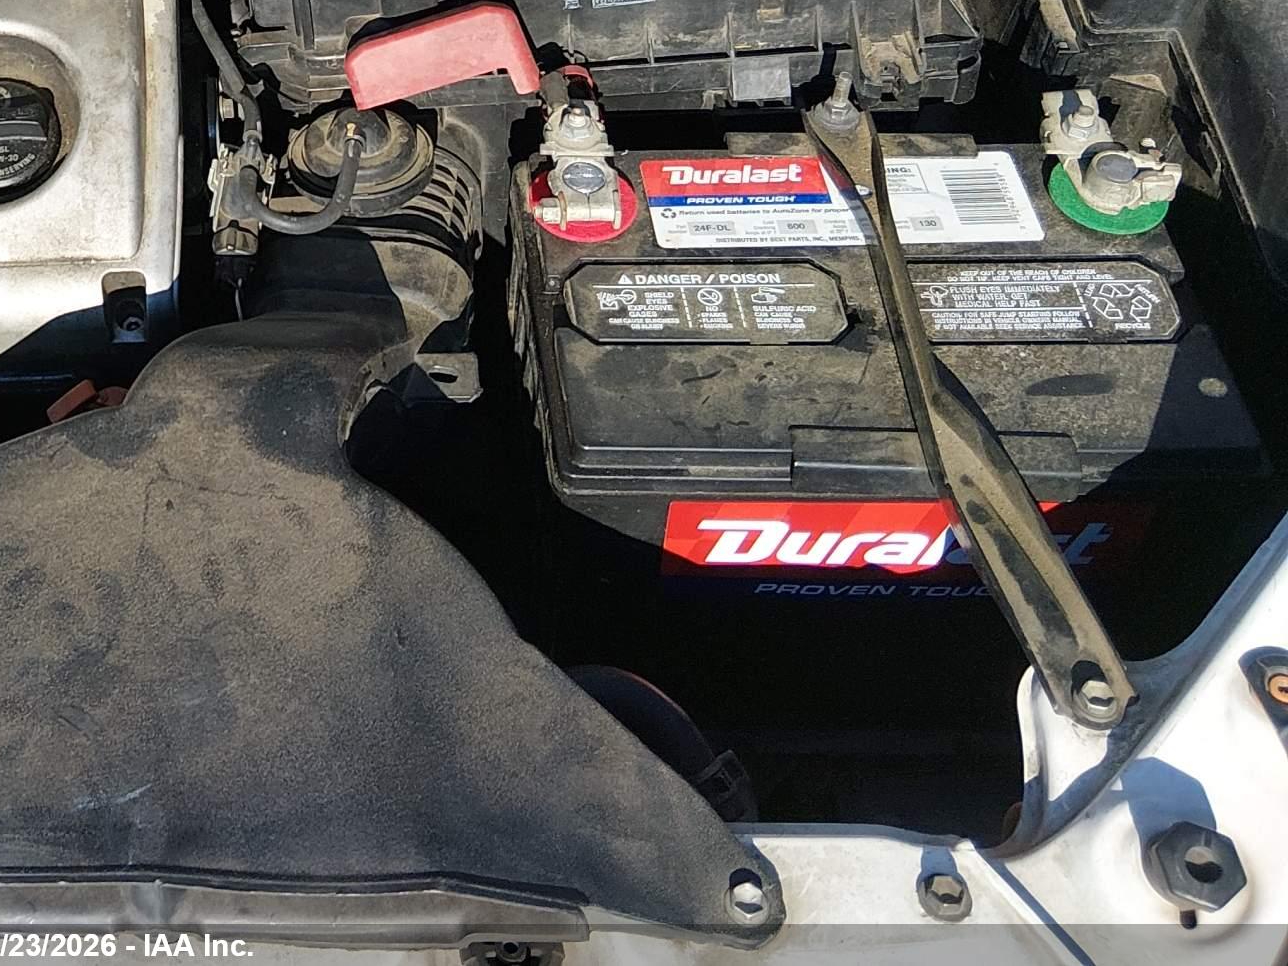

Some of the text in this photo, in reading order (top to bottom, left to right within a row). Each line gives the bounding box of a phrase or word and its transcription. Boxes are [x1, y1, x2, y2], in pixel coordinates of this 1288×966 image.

[0, 145, 10, 154] SL
[662, 164, 803, 185] Duralast
[687, 195, 796, 205] PROVEN TOUGH
[693, 224, 732, 232] 24F-DL
[634, 273, 781, 284] DANGER / POISON
[1004, 284, 1060, 293] IMMEDIATELY
[644, 291, 674, 299] SHIELD
[954, 299, 1041, 308] MEDICAL HELP FAST
[1114, 322, 1151, 330] RECYCLE
[696, 519, 1112, 567] Duralt
[753, 582, 996, 597] PROVEN TOUG
